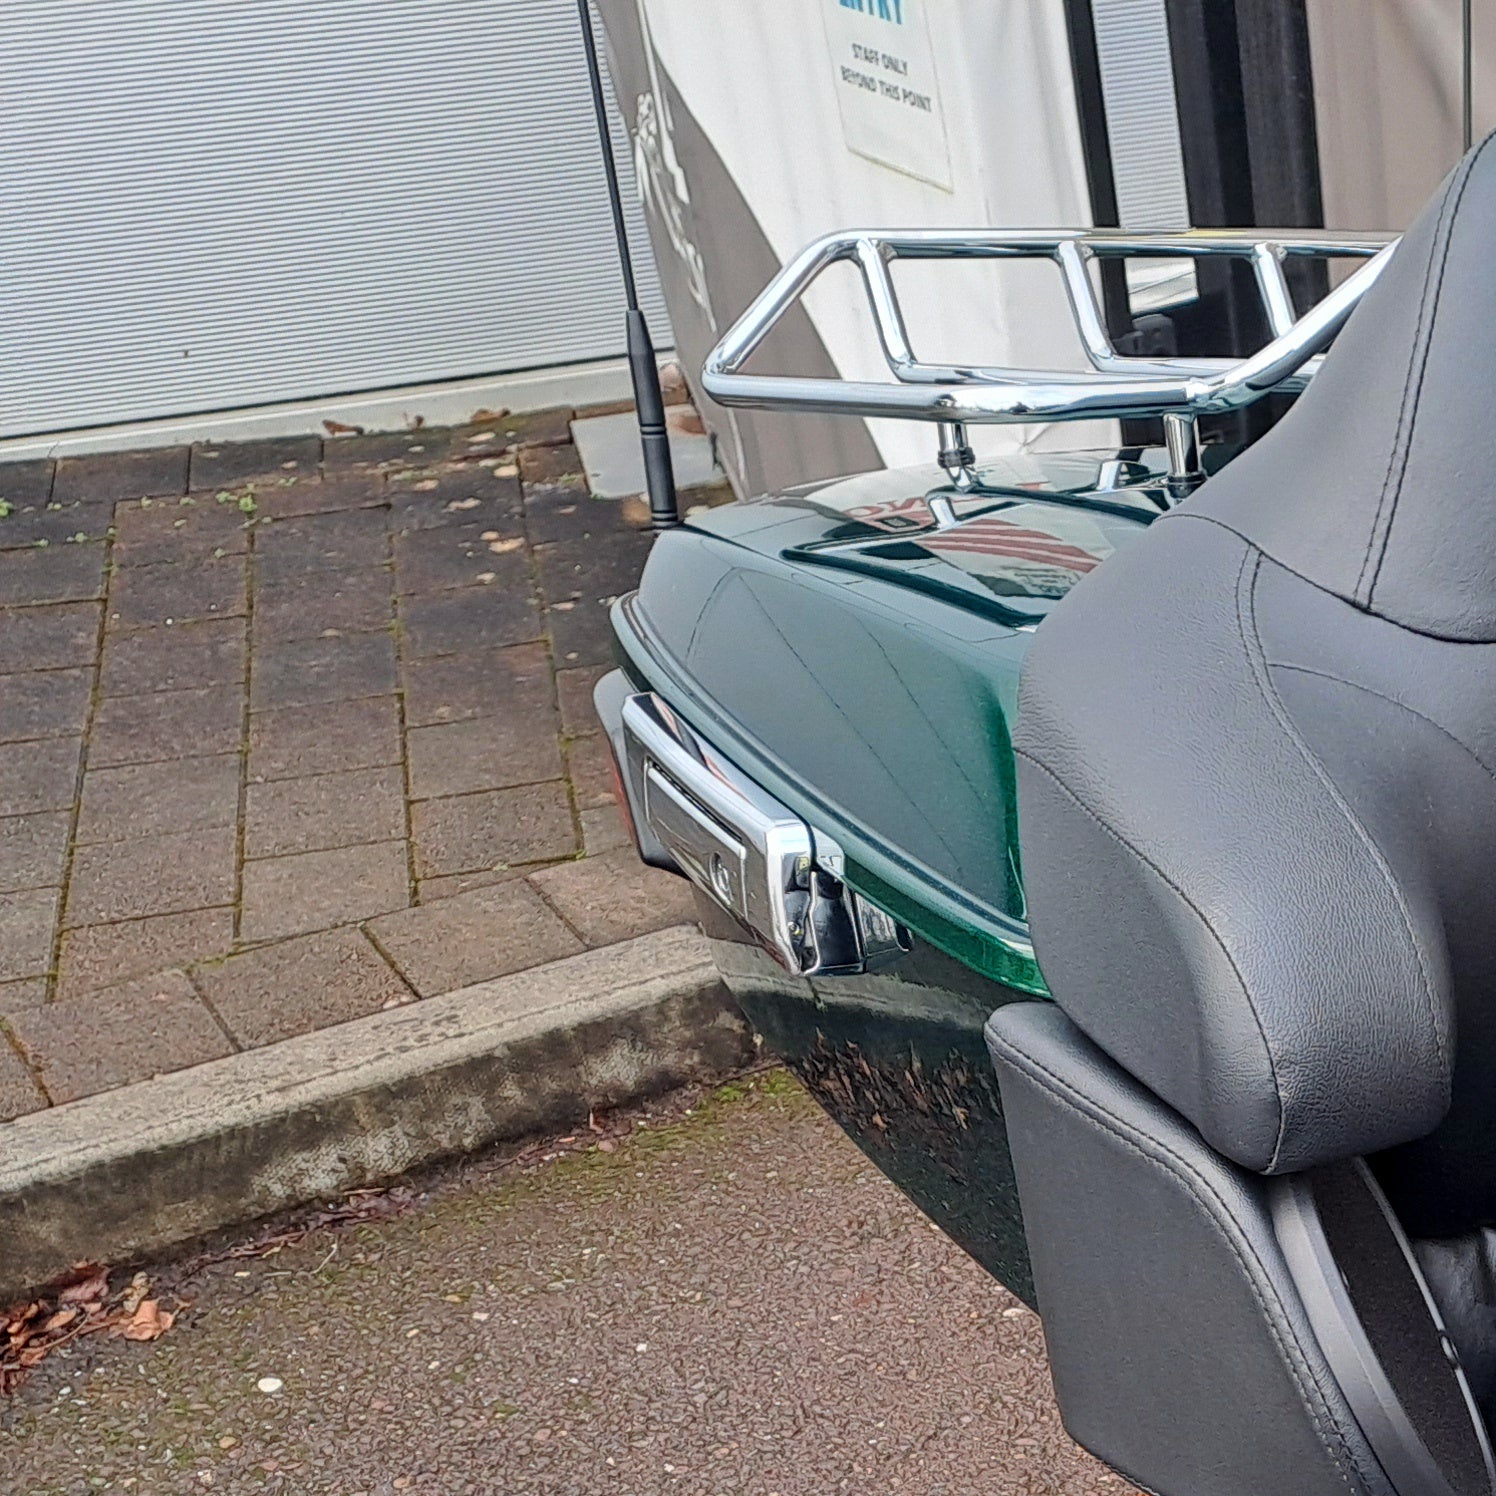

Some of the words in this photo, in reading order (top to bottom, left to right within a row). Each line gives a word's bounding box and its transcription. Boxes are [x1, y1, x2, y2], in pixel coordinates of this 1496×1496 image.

[852, 43, 879, 66] STAFF
[881, 53, 908, 76] ONLY
[840, 65, 877, 92] BEYOND
[878, 79, 900, 101] THIS
[902, 88, 932, 112] POINT
